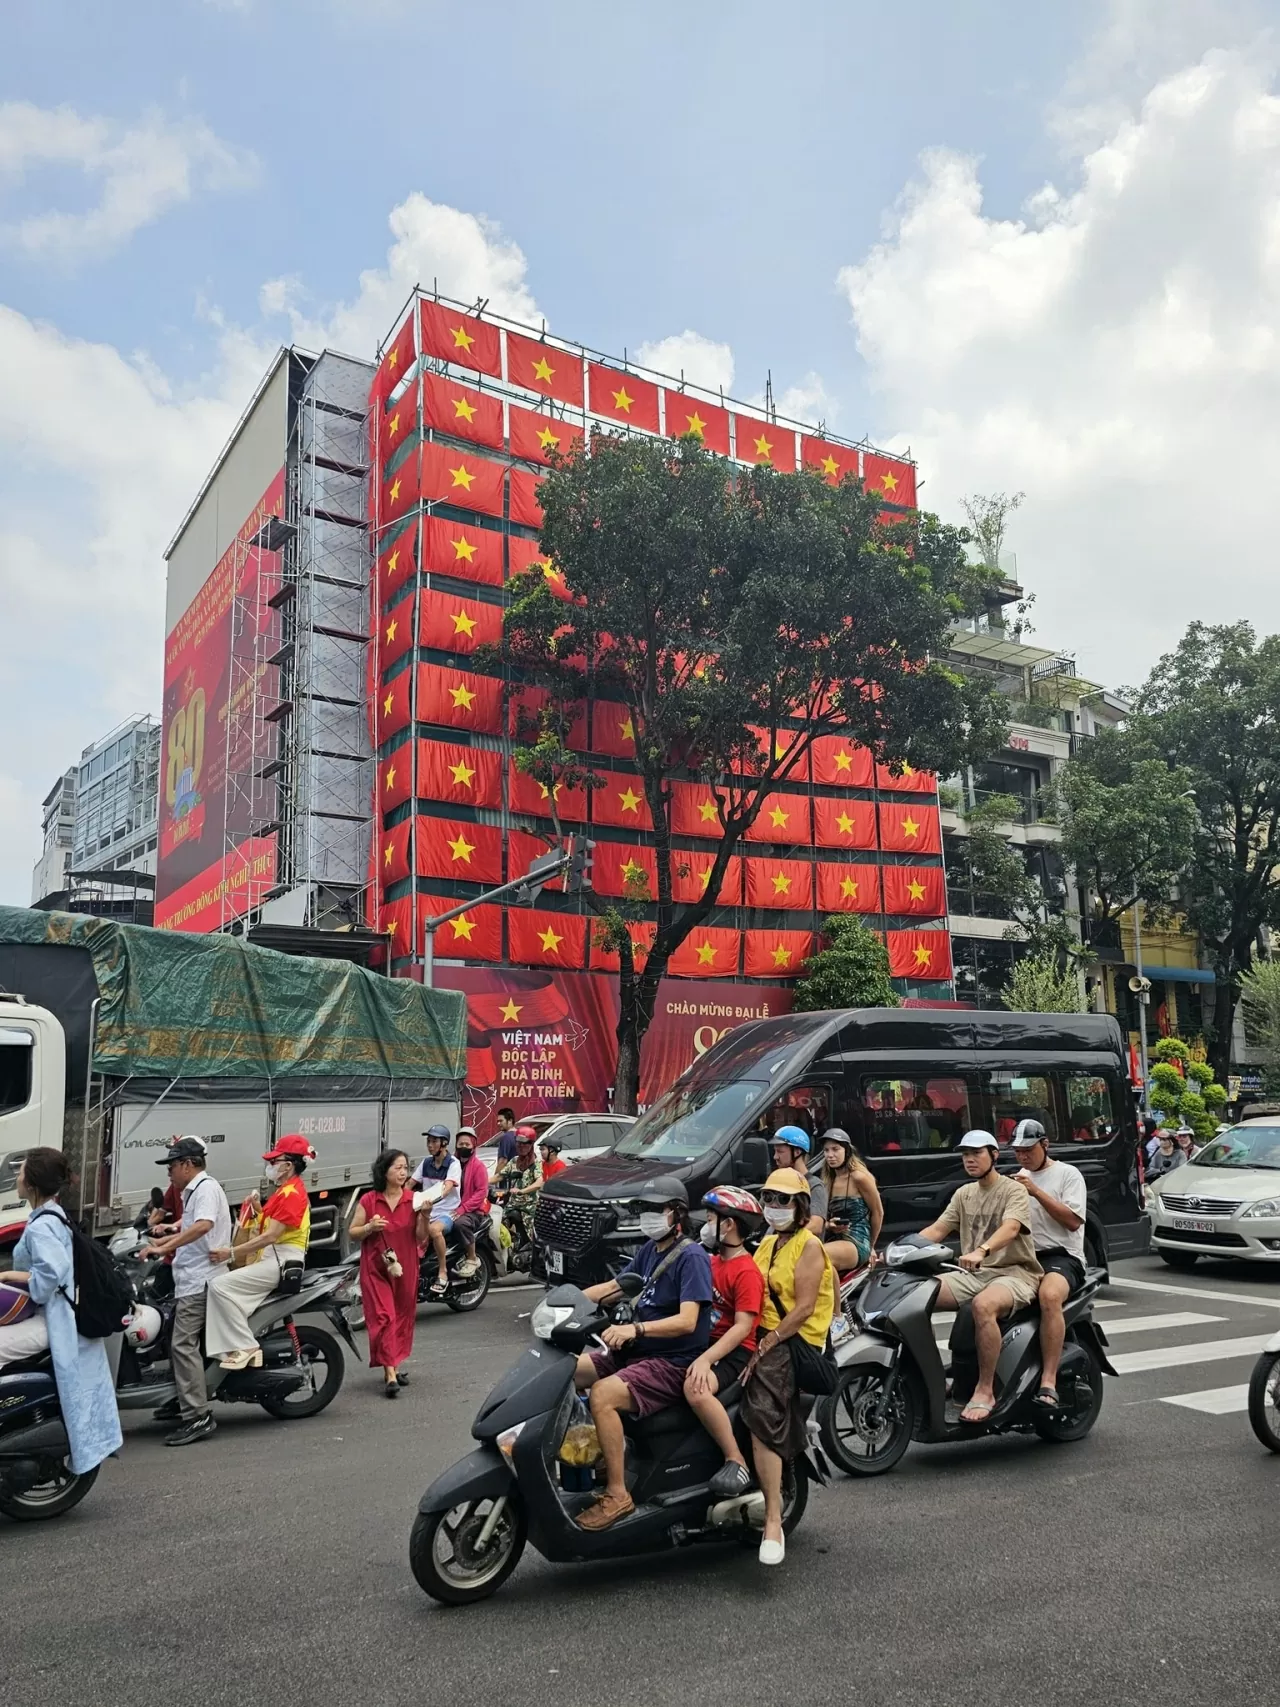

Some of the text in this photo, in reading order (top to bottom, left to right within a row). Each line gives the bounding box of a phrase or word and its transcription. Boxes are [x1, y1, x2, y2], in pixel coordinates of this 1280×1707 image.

[166, 687, 206, 807] 80
[666, 1000, 770, 1021] CHÀO MỪNG ĐẠI LỄ
[502, 1029, 563, 1048] VIỆT NAM
[501, 1047, 557, 1066] ĐỘC LẬP
[501, 1065, 563, 1080] HOÀ BÌNH
[500, 1081, 575, 1098] PHÁT TRIỂN
